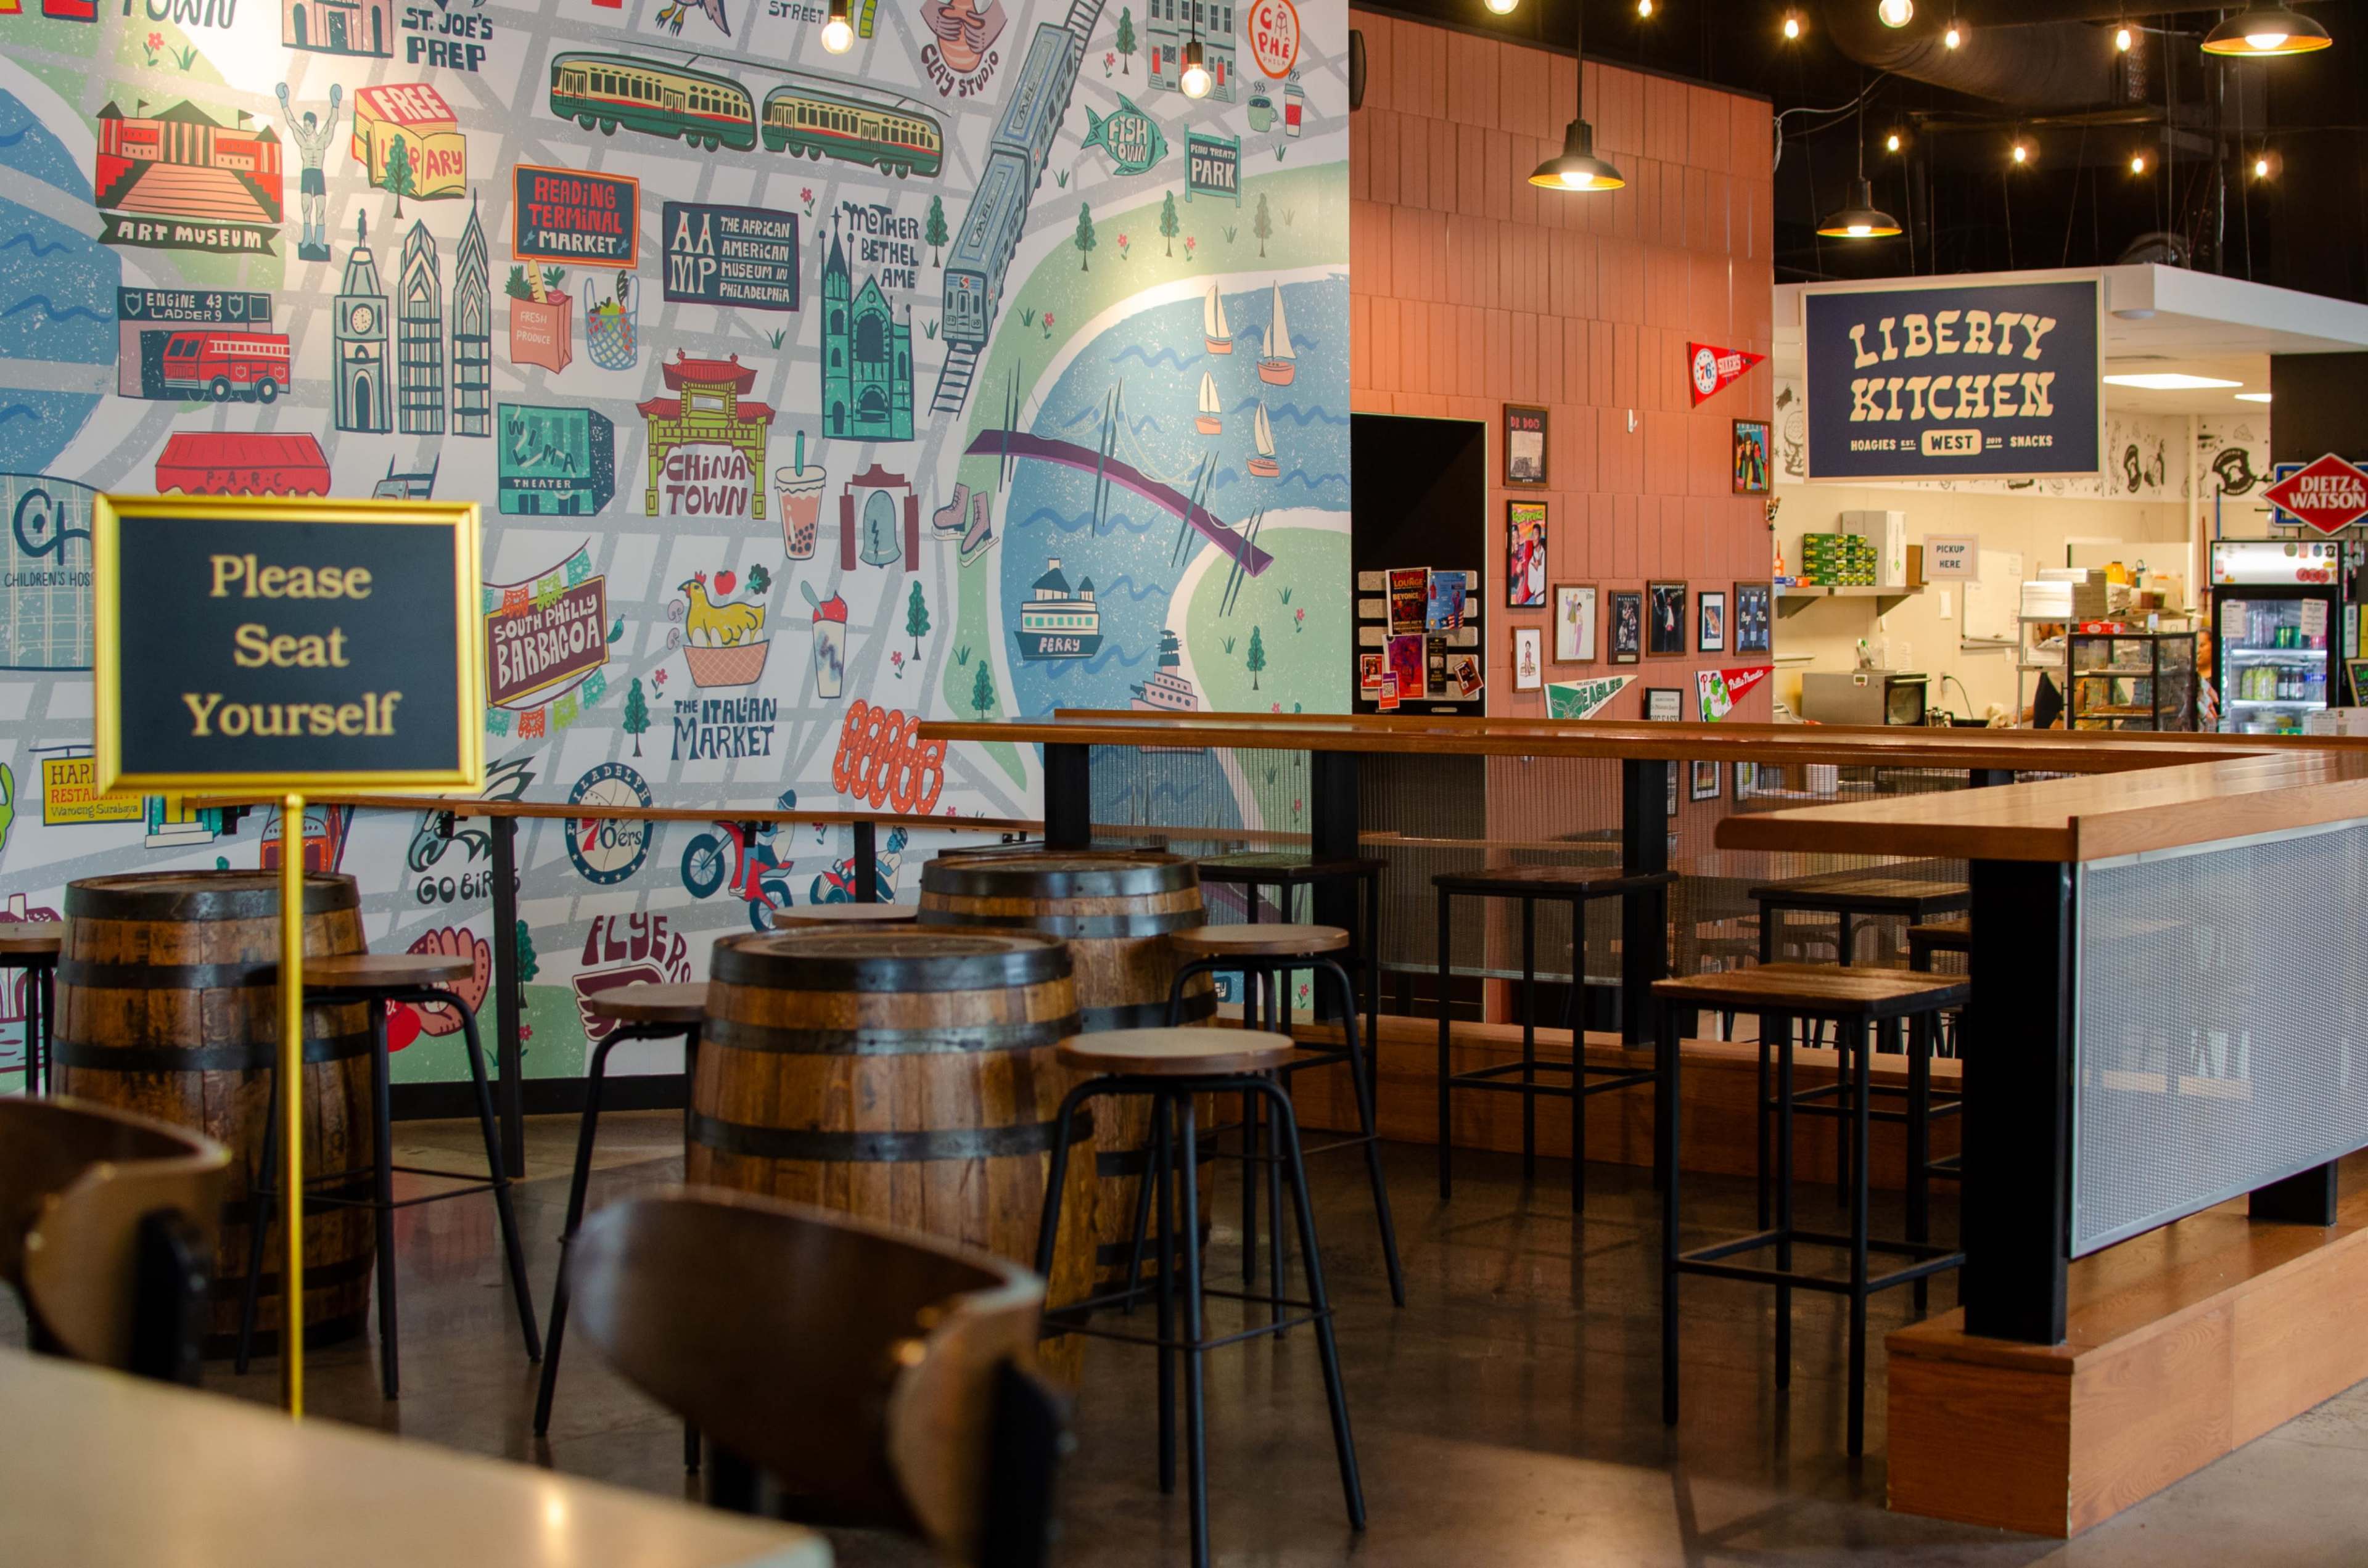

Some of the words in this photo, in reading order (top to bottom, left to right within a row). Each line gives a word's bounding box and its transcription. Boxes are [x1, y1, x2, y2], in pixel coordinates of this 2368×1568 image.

[401, 7, 434, 31] ST.
[439, 12, 493, 40] JOE'S
[769, 2, 824, 25] STREET
[407, 36, 486, 72] PREP
[921, 44, 955, 97] CLAY
[959, 51, 998, 97] STUDIO
[371, 85, 451, 122] FREE
[1108, 115, 1148, 146] FISH
[1109, 142, 1147, 165] TOWN
[1191, 144, 1209, 155] PENN
[1209, 147, 1236, 160] TREATY
[1191, 157, 1236, 189] PARK
[535, 177, 616, 210] READING
[528, 203, 623, 234] TERMINAL
[721, 216, 740, 233] THE
[742, 219, 791, 238] AFRICAN
[842, 200, 919, 240] MOTHER
[118, 221, 168, 241] ART
[175, 226, 261, 248] MUSEUM
[539, 231, 617, 255] MARKET
[722, 240, 789, 261] AMERICAN
[861, 237, 919, 267] BETHEL
[722, 261, 772, 279] MUSEUM
[776, 268, 788, 280] IN
[881, 269, 916, 289] AME
[146, 293, 195, 308] ENGINE
[207, 295, 222, 308] 43
[151, 309, 212, 321] LADDER
[215, 310, 222, 321] 9
[520, 311, 547, 324] FRESH
[516, 330, 551, 345] PRODUCE
[1849, 310, 2057, 369] LIBERTY
[1699, 362, 1712, 381] 76
[1849, 372, 2055, 422] KITCHEN
[507, 418, 577, 474] WILMA
[1851, 439, 1896, 451] HOAGIES
[1931, 435, 1973, 450] WEST
[2010, 435, 2053, 448] SNACKS
[665, 453, 747, 482] CHINA
[513, 478, 572, 490] THEATER
[2300, 475, 2351, 493] DIETZ
[2352, 478, 2365, 492] &
[665, 487, 747, 516] TOWN
[2288, 492, 2367, 509] WATSON
[1936, 544, 1965, 553] PICKUP
[210, 554, 372, 599] Please
[1939, 560, 1961, 569] HERE
[4, 572, 65, 588] CHILDREN'S
[70, 572, 97, 586] HOS
[495, 613, 543, 642] SOUTH
[545, 593, 598, 628] PHILLY
[234, 623, 350, 668] Seat
[498, 615, 601, 691] BARBACOA
[1038, 637, 1080, 653] FERRY
[1579, 677, 1623, 712] EAGLES
[183, 691, 403, 736] Yourself
[674, 699, 698, 713] THE
[702, 697, 777, 724] ITALIAN
[671, 716, 775, 761] MARKET
[51, 763, 97, 786] HAR
[51, 805, 95, 818] Waroeng
[96, 803, 138, 819] Surabaya
[582, 818, 643, 853] 76ers
[417, 876, 456, 905] GO
